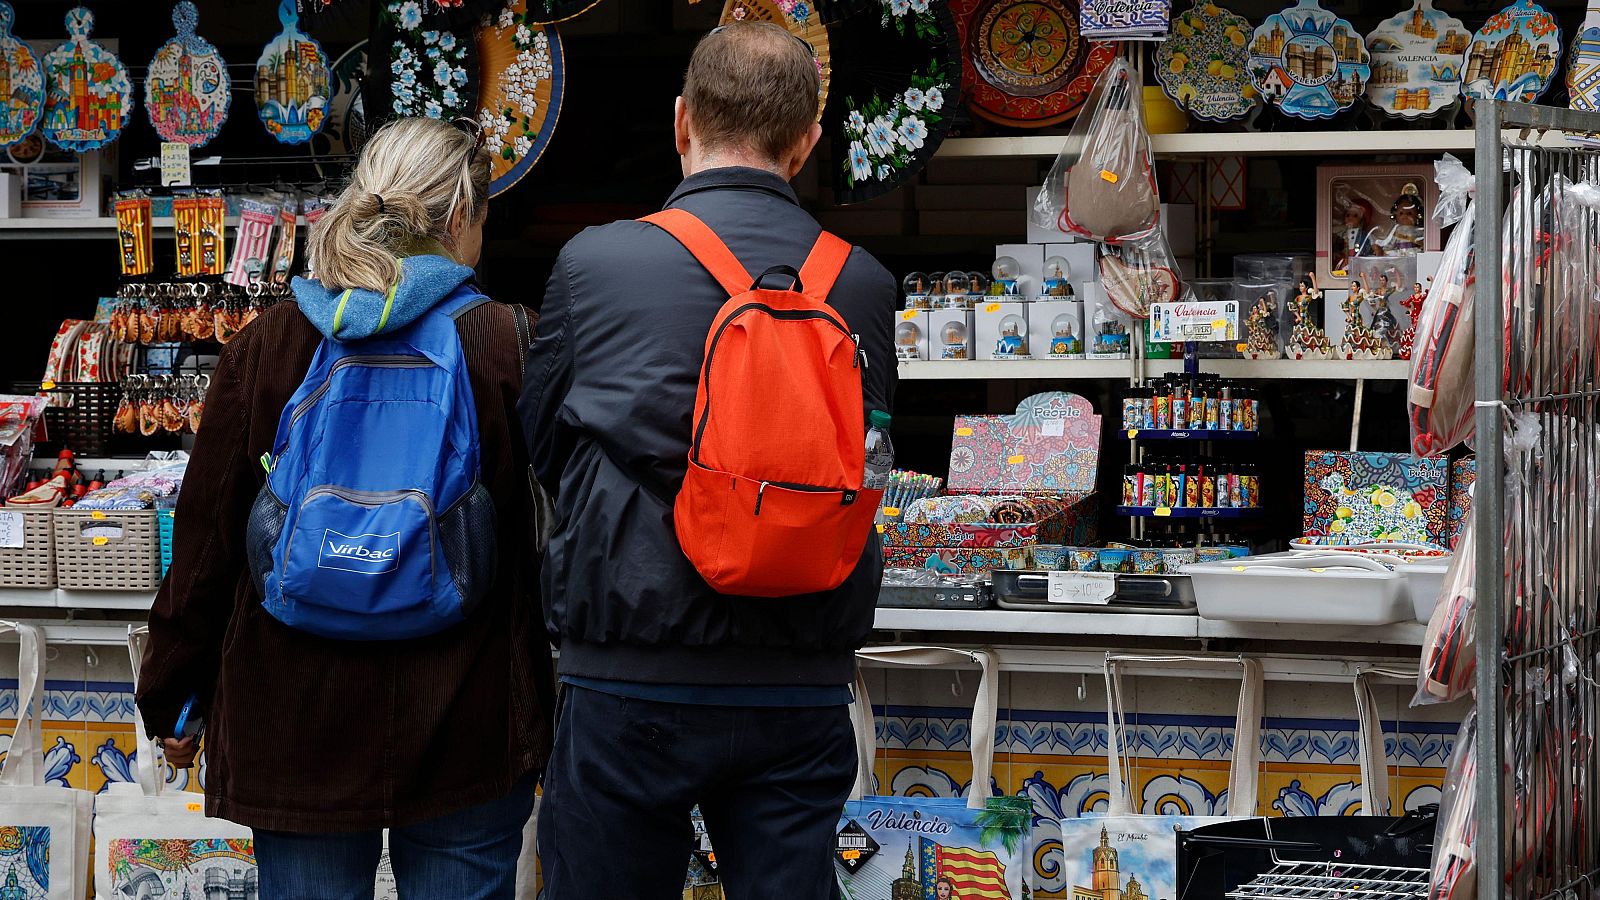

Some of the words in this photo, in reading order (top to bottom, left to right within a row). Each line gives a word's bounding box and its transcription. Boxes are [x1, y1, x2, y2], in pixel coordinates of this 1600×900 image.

[1094, 1, 1153, 15] Valencia
[1289, 70, 1332, 85] VALENCIA
[1207, 95, 1235, 103] Valencia
[1174, 304, 1217, 317] Valencia
[1033, 407, 1080, 418] People
[1408, 469, 1442, 478] People
[945, 533, 975, 541] People
[328, 540, 394, 559] Virbac
[1053, 583, 1064, 598] 5
[868, 808, 953, 835] Valencia
